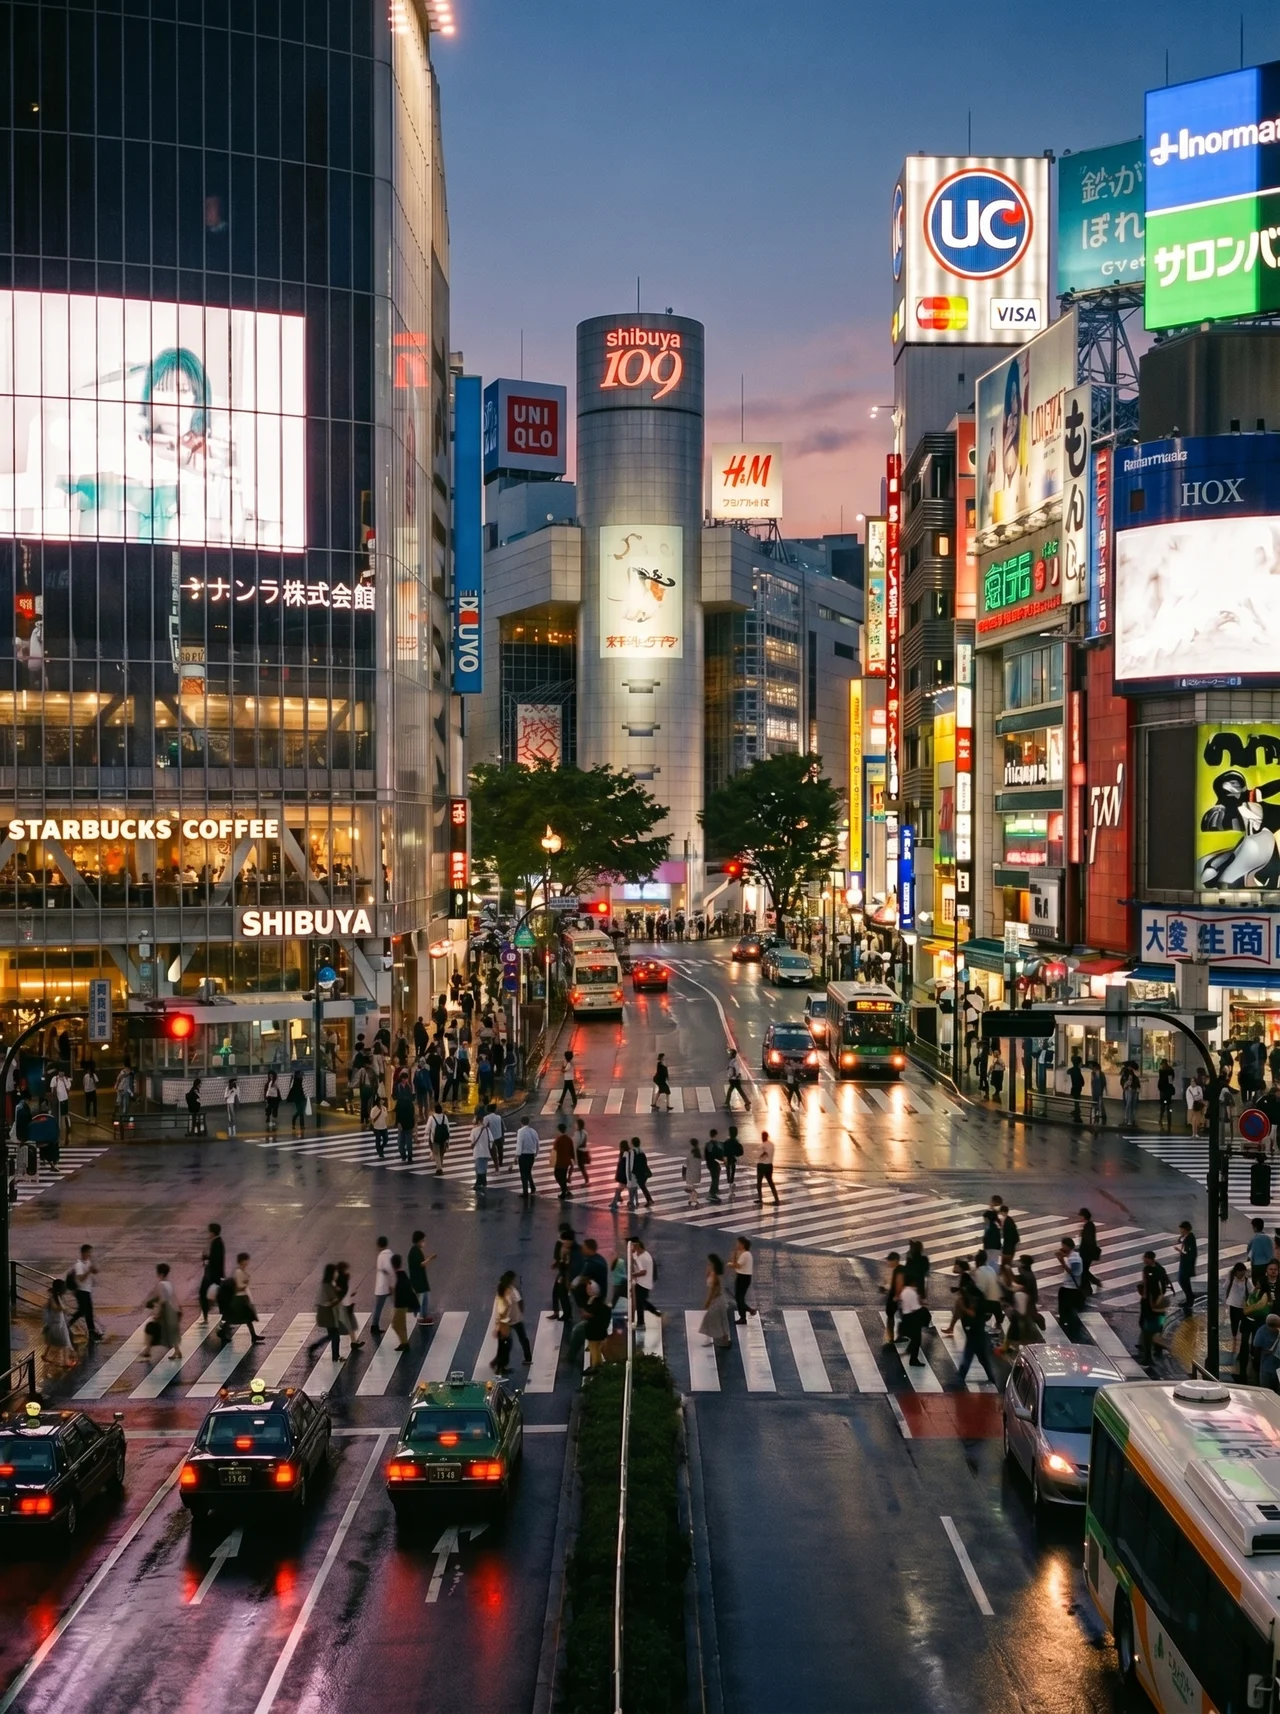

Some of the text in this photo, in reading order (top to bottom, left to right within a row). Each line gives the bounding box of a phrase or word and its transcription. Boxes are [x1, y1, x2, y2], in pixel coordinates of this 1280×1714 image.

[941, 199, 1021, 249] UC
[1154, 227, 1280, 288] サロンバ
[996, 306, 1037, 322] VISA
[606, 327, 681, 351] shibuya
[600, 349, 683, 400] 109
[514, 404, 549, 425] UNI
[514, 427, 553, 449] QLO
[722, 454, 772, 488] H&M
[1181, 477, 1246, 507] HOX
[8, 819, 279, 841] STARBUCKS COFFEE
[242, 908, 372, 937] SHIBUYA
